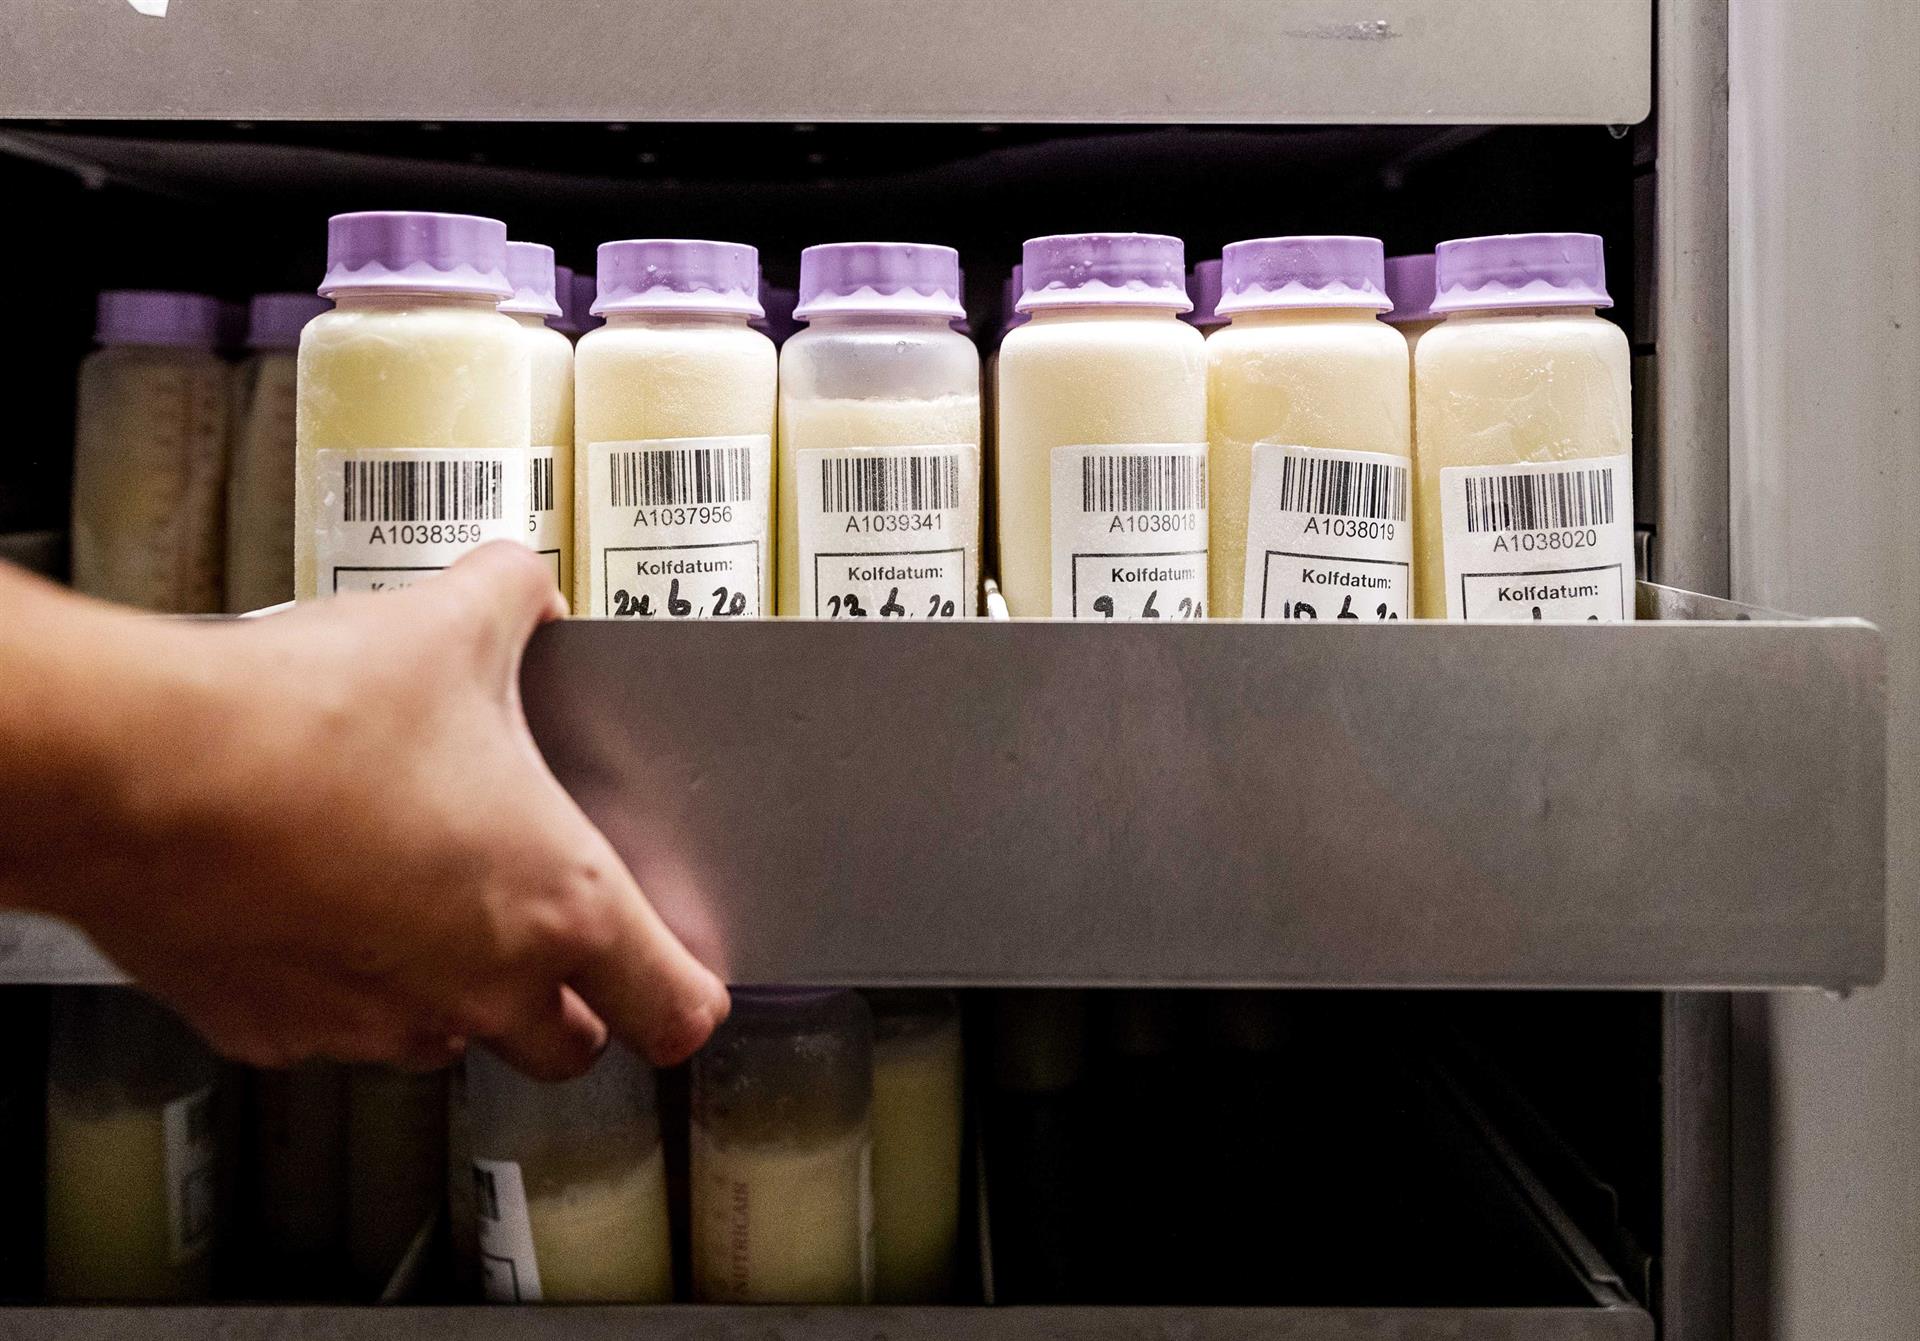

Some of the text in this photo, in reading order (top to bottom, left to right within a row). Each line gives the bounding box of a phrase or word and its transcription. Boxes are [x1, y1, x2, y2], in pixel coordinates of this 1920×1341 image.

[633, 505, 733, 527] A1037956
[845, 513, 943, 533] A1039341
[1108, 513, 1196, 533] A1038018
[368, 524, 482, 545] A1038359
[1303, 516, 1395, 541] A1038019
[1492, 528, 1598, 553] A1038020
[636, 559, 734, 576] Kolfdatum:
[847, 566, 944, 582] Kolfdatum:
[1111, 567, 1196, 583] Kolfdatum:
[1302, 568, 1392, 590] Kolfdatum:
[1497, 584, 1599, 602] Kolfdatum:
